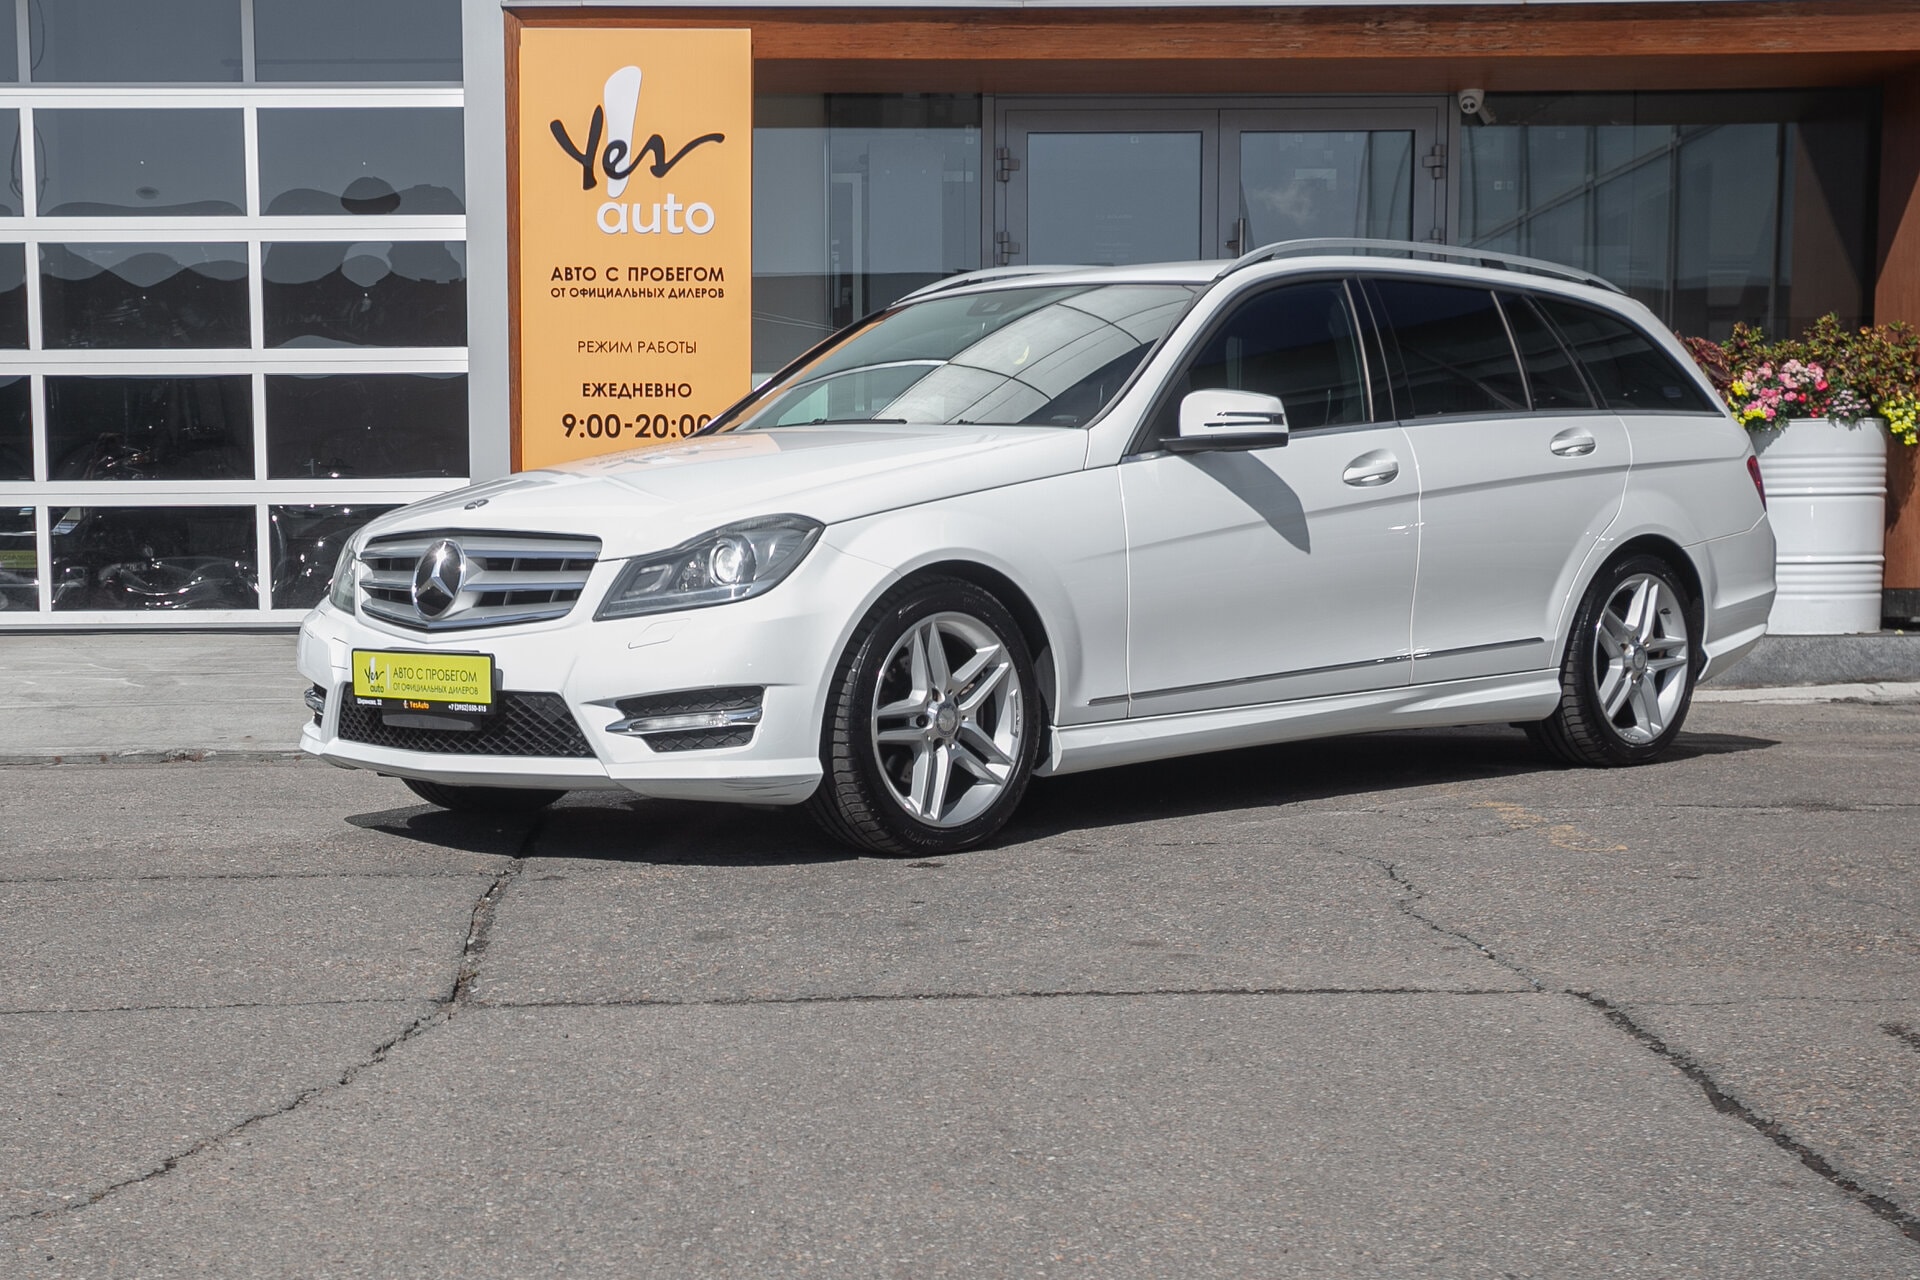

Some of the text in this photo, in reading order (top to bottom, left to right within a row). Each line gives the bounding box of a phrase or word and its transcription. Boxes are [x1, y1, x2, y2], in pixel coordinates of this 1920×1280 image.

[596, 193, 716, 235] auto
[550, 266, 725, 282] АВТО С ПРОБЕГОМ
[550, 287, 725, 299] ОТ ОФИЦИАЛЬНЫХ ДИЛЕРОВ
[577, 340, 697, 353] РЕЖИМ РАБОТЫ
[582, 383, 692, 399] ЕЖЕДНЕВНО
[393, 667, 477, 683] АВТО С ПРОБЕГОМ
[370, 683, 384, 693] auto
[393, 682, 479, 696] ОТ ОФИЦИАЛЬНЫХ ДИЛЕРОВ
